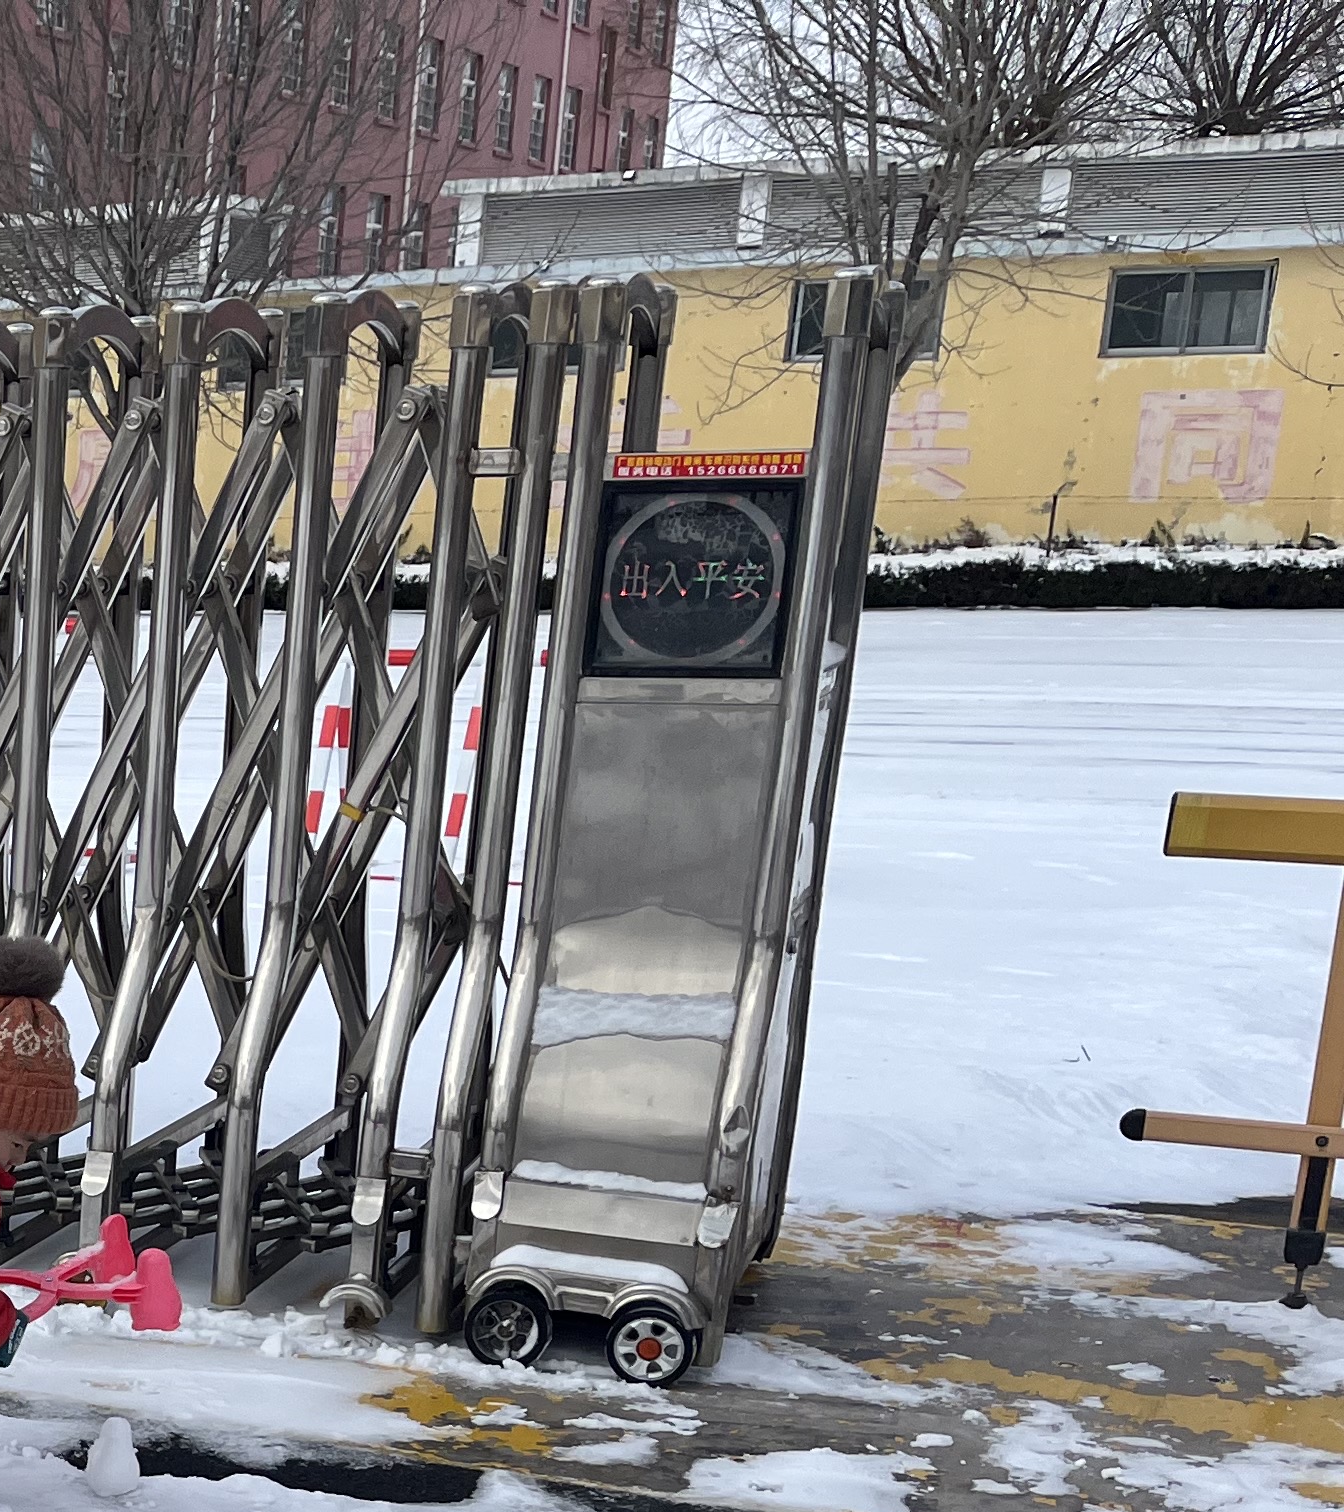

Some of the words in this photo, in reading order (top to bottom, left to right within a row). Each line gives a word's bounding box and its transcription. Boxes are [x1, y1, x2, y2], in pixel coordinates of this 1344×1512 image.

[687, 464, 799, 476] 15266666971
[619, 558, 766, 600] 出入平安
